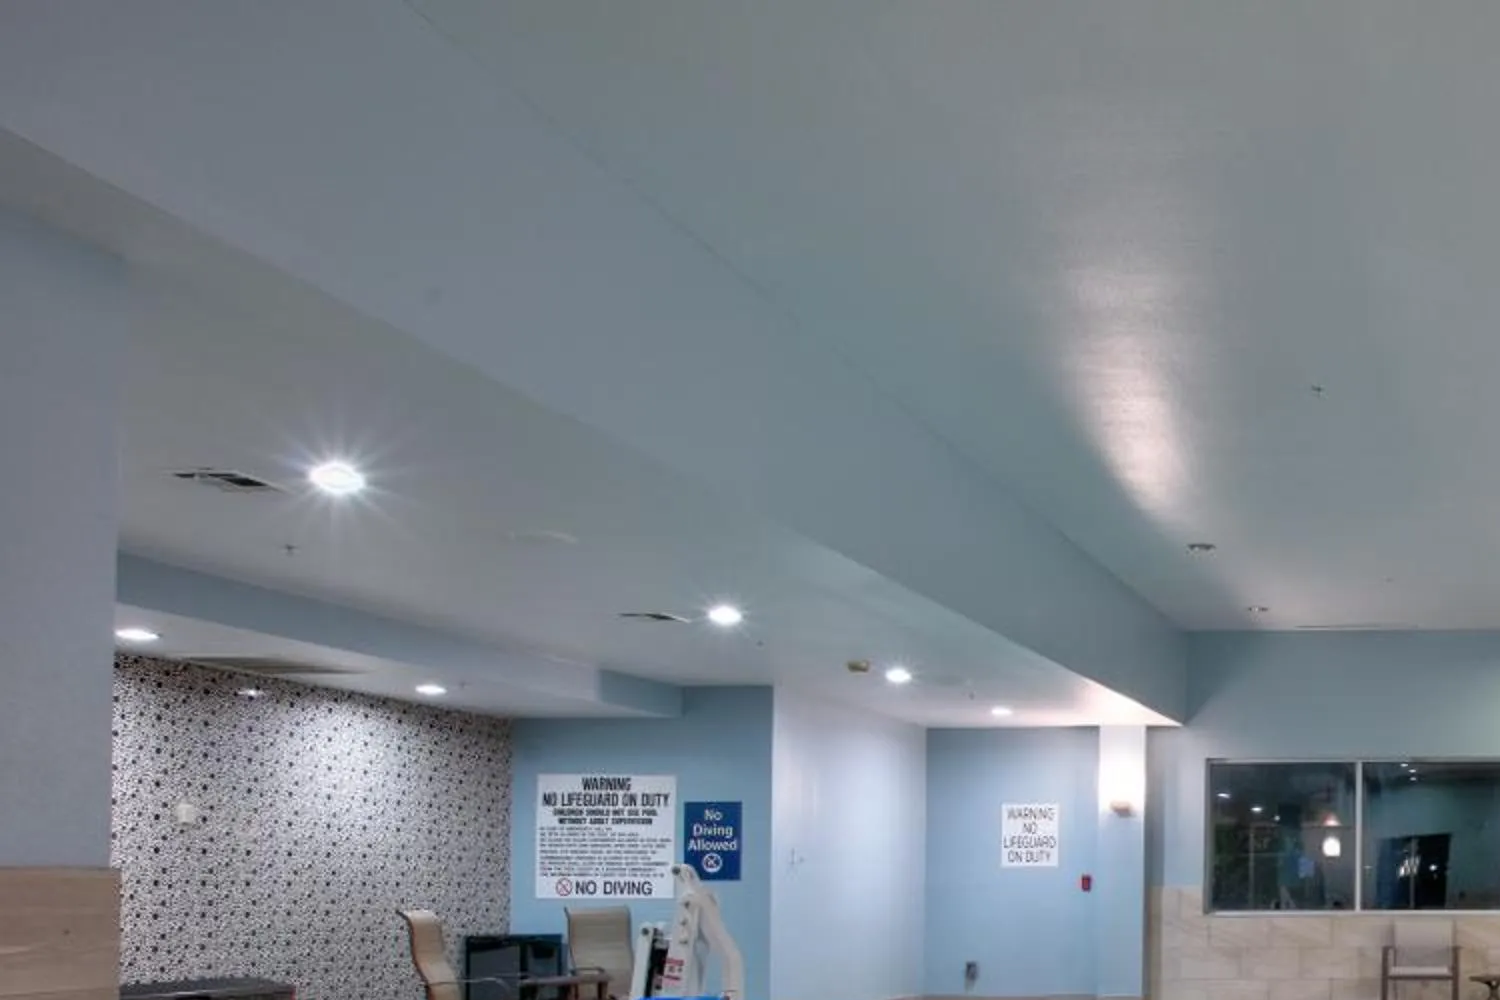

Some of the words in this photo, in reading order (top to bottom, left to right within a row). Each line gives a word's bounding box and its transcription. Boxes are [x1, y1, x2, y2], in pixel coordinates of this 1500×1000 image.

[582, 777, 631, 791] WARNING
[542, 792, 557, 806] NO
[561, 792, 618, 807] LIFEGUARD
[622, 792, 637, 807] ON
[641, 792, 670, 807] DUTY
[704, 809, 722, 821] No
[1007, 807, 1055, 820] WARNING
[693, 824, 733, 839] Diving
[1023, 821, 1037, 834] NO
[688, 838, 737, 851] Allowed
[1003, 835, 1056, 848] LIFEGUARD
[1008, 850, 1023, 863] ON
[1025, 850, 1051, 863] DUTY
[575, 881, 597, 895] NO
[603, 881, 653, 896] DIVING
